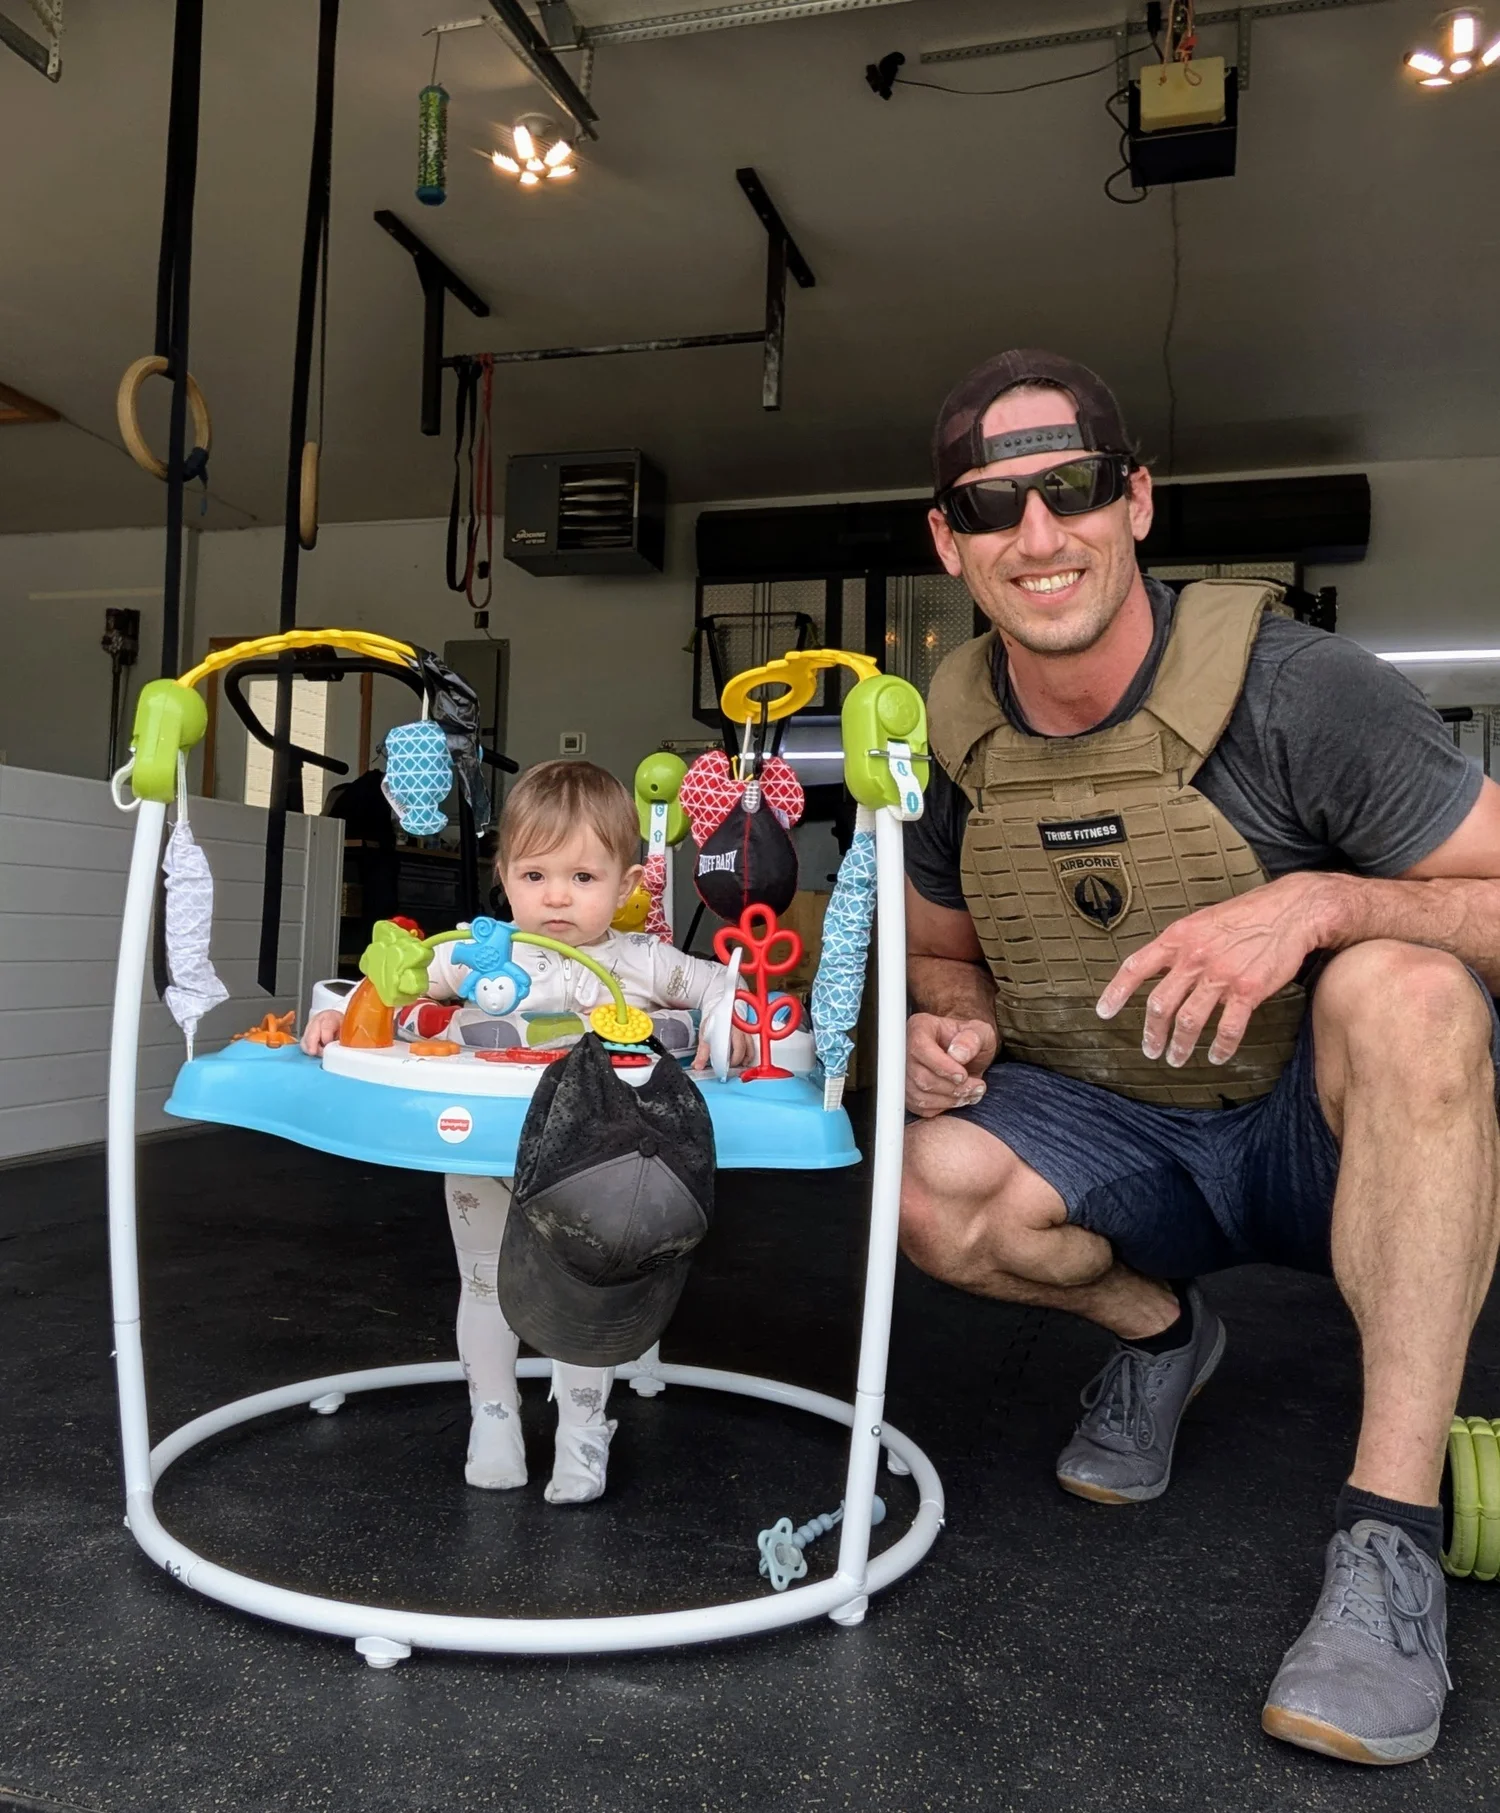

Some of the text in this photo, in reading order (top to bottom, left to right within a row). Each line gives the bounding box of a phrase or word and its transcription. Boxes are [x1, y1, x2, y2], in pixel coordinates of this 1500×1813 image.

[1045, 824, 1118, 842] TRIBE FITNESS
[715, 849, 738, 873] BABY
[1060, 857, 1120, 872] AIRBORNE
